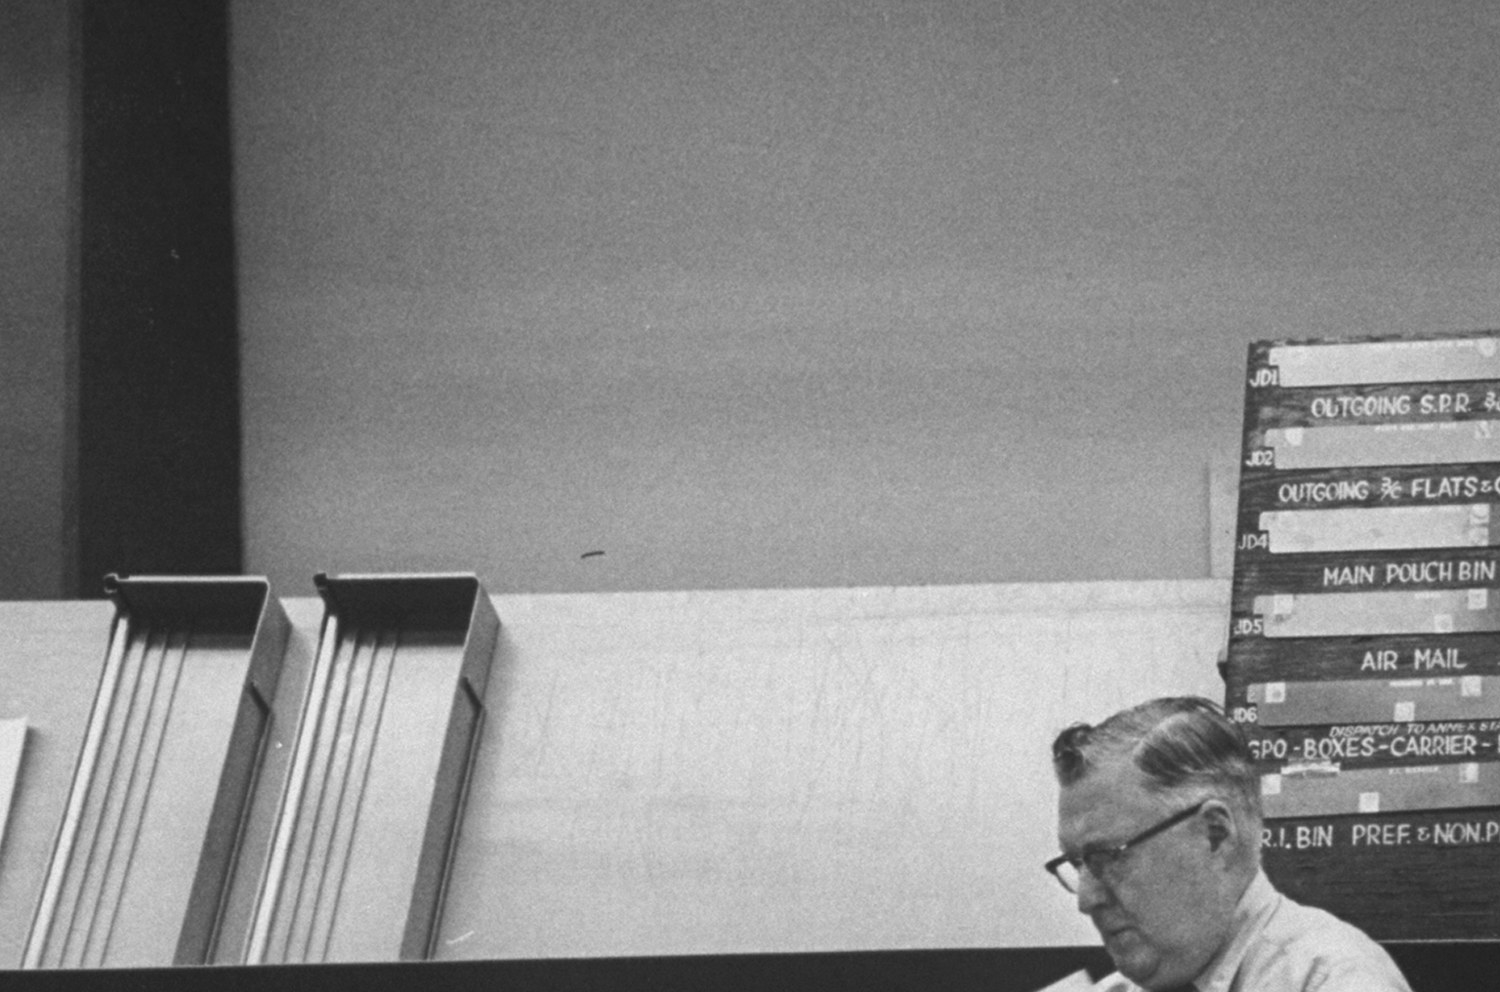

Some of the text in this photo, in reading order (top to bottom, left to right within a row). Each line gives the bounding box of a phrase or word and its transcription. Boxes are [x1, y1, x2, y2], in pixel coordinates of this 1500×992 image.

[1250, 370, 1279, 387] JD1
[1311, 395, 1411, 418] OUTGOING
[1246, 451, 1273, 467] JD2
[1279, 480, 1369, 502] OUTGOING
[1238, 534, 1268, 550] JD4
[1324, 560, 1495, 587] MAIN POUCH BIN
[1234, 619, 1262, 635] JD5
[1360, 649, 1467, 672] AIR MAIL
[1297, 825, 1333, 849] BIN
[1352, 824, 1411, 846] PREF.
